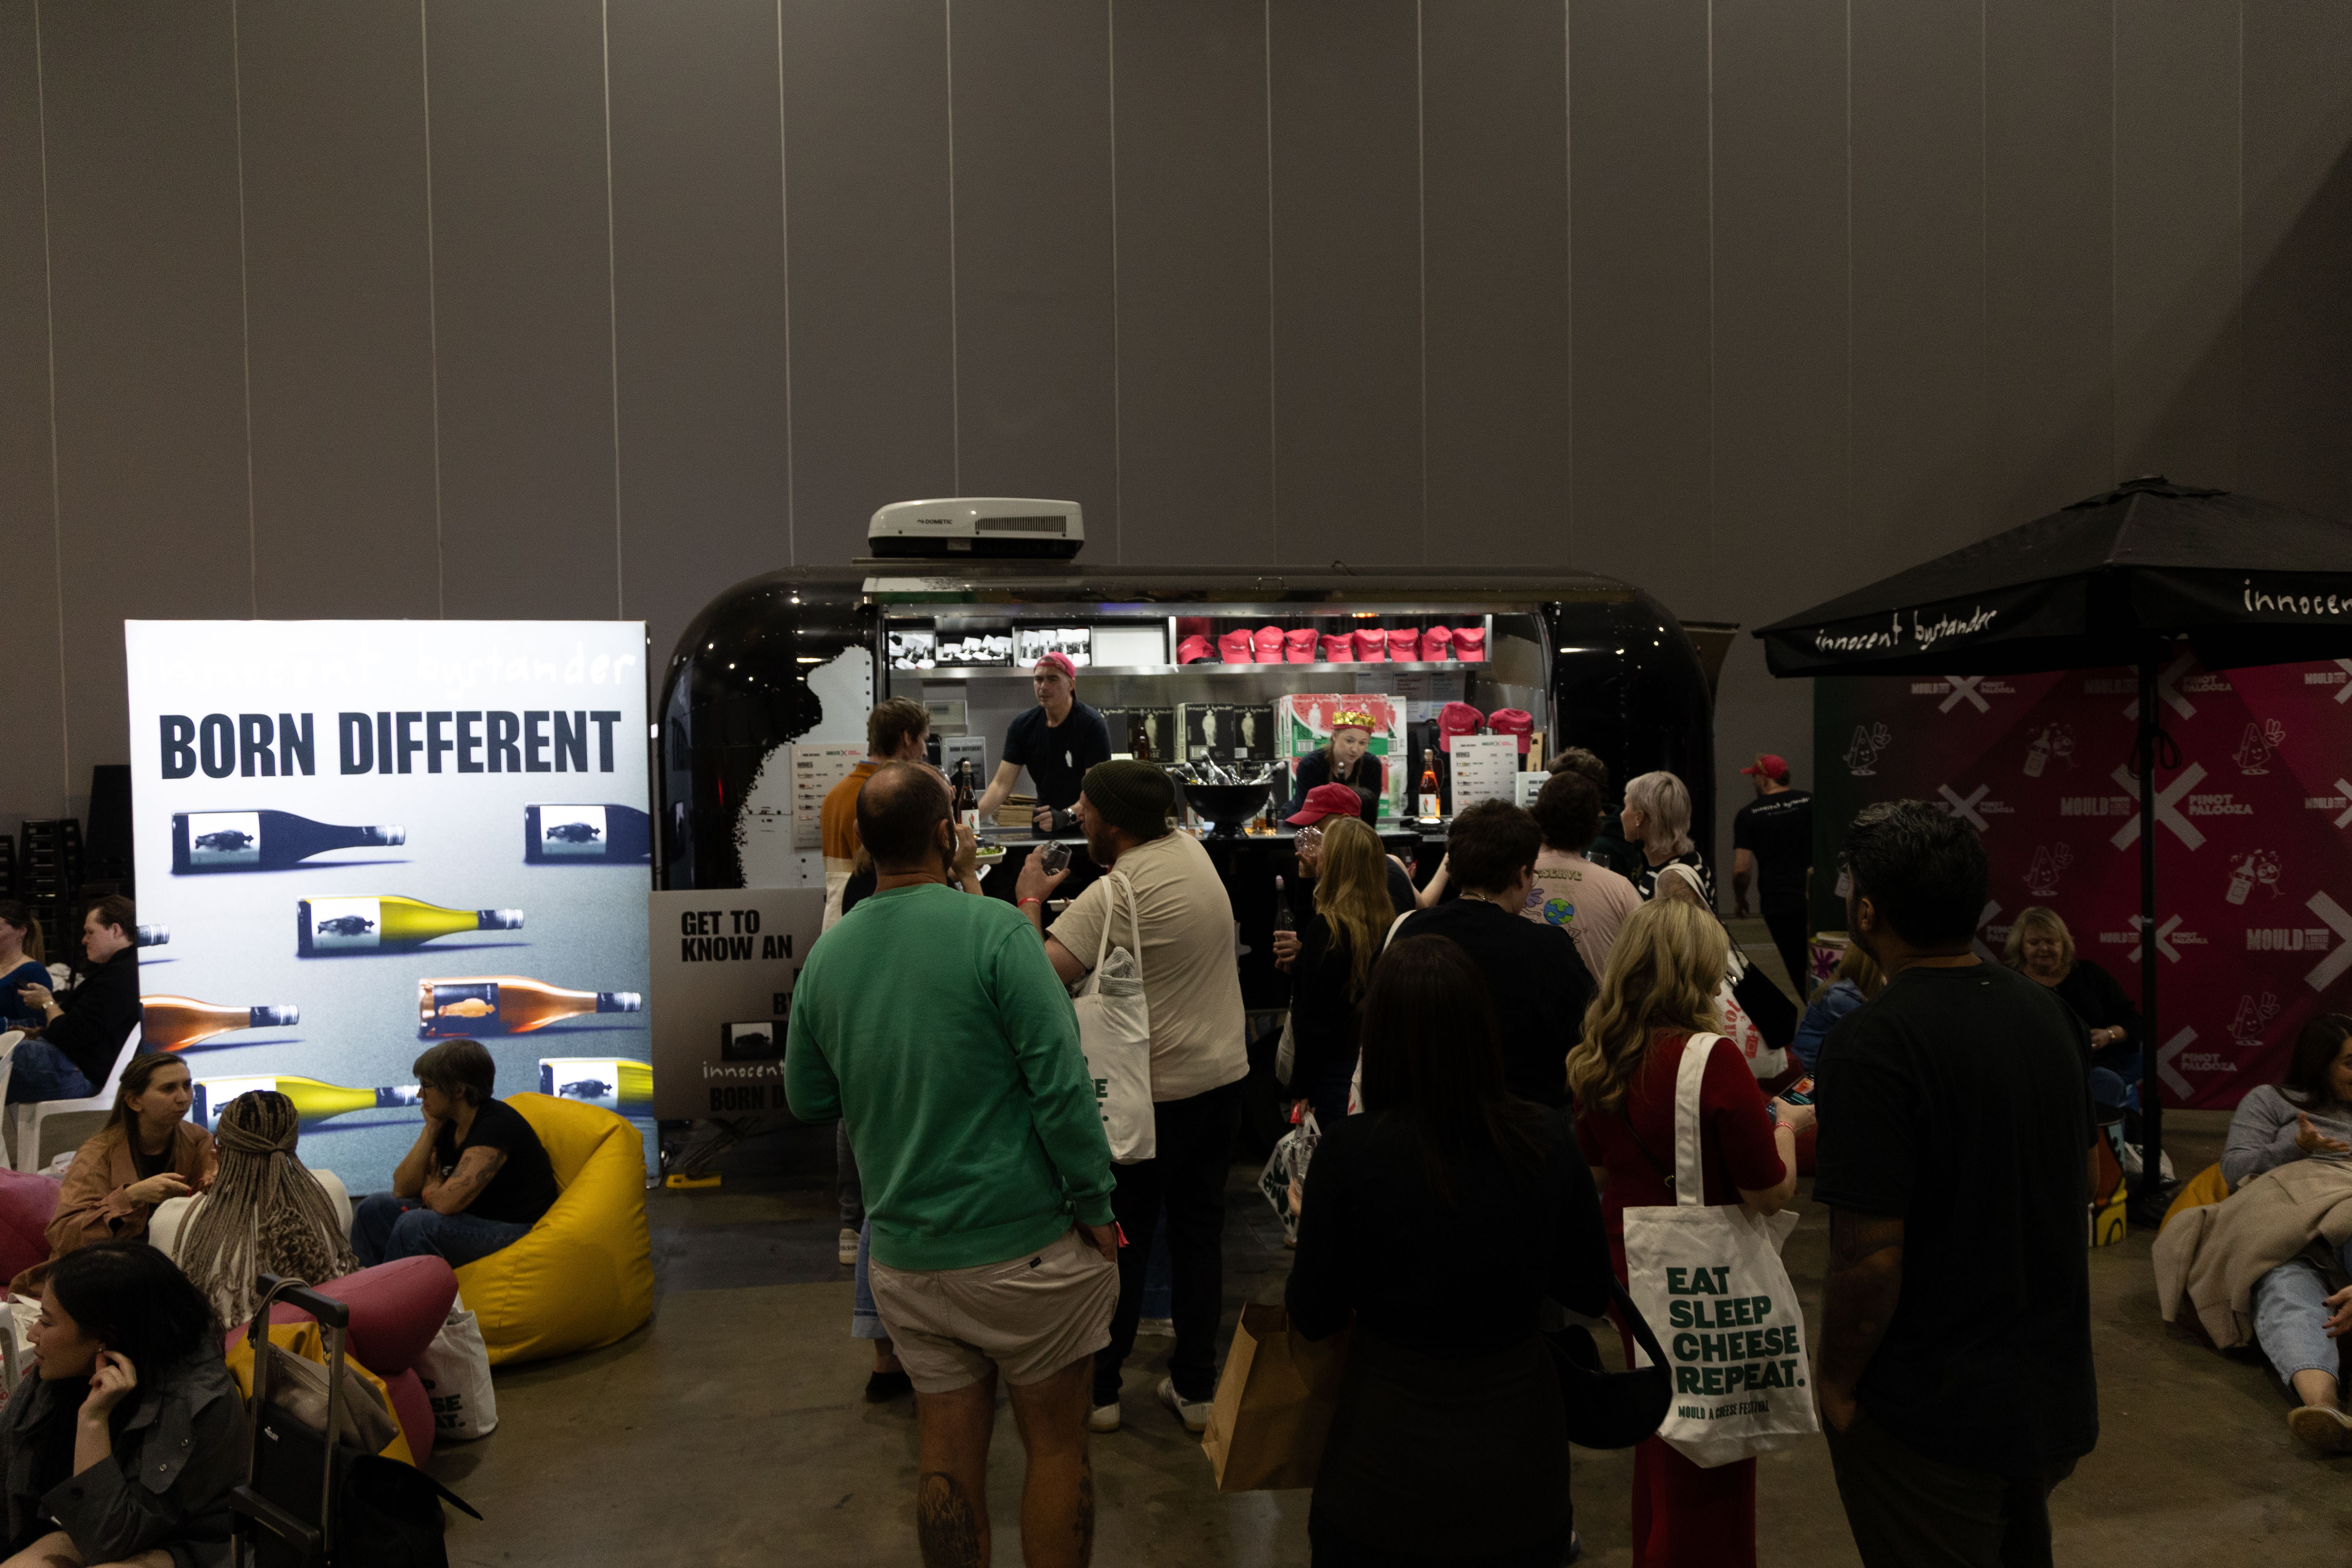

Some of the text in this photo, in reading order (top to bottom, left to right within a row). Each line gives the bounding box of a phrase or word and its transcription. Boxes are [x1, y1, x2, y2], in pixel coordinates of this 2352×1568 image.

[1815, 606, 1997, 652] innocent bystander
[417, 633, 636, 700] bystander
[159, 710, 622, 779] BORN DIFFERENT
[2061, 797, 2108, 816] MOULD
[2189, 794, 2233, 804] PINOT
[2189, 804, 2253, 815] PALOOZA
[682, 910, 759, 935] GET TO
[682, 935, 792, 962] KNOW AN
[2247, 929, 2303, 950] MOULD
[703, 1059, 785, 1078] innocent
[2181, 1053, 2221, 1062] PINOT
[710, 1086, 763, 1111] BORN
[1666, 1266, 1730, 1295] EAT
[1669, 1295, 1772, 1329] SLEEP
[1673, 1325, 1801, 1362] CHEESE
[1675, 1359, 1806, 1395] REPEAT.
[1678, 1400, 1770, 1420] MOULD A CHEESE FESTIVAL
